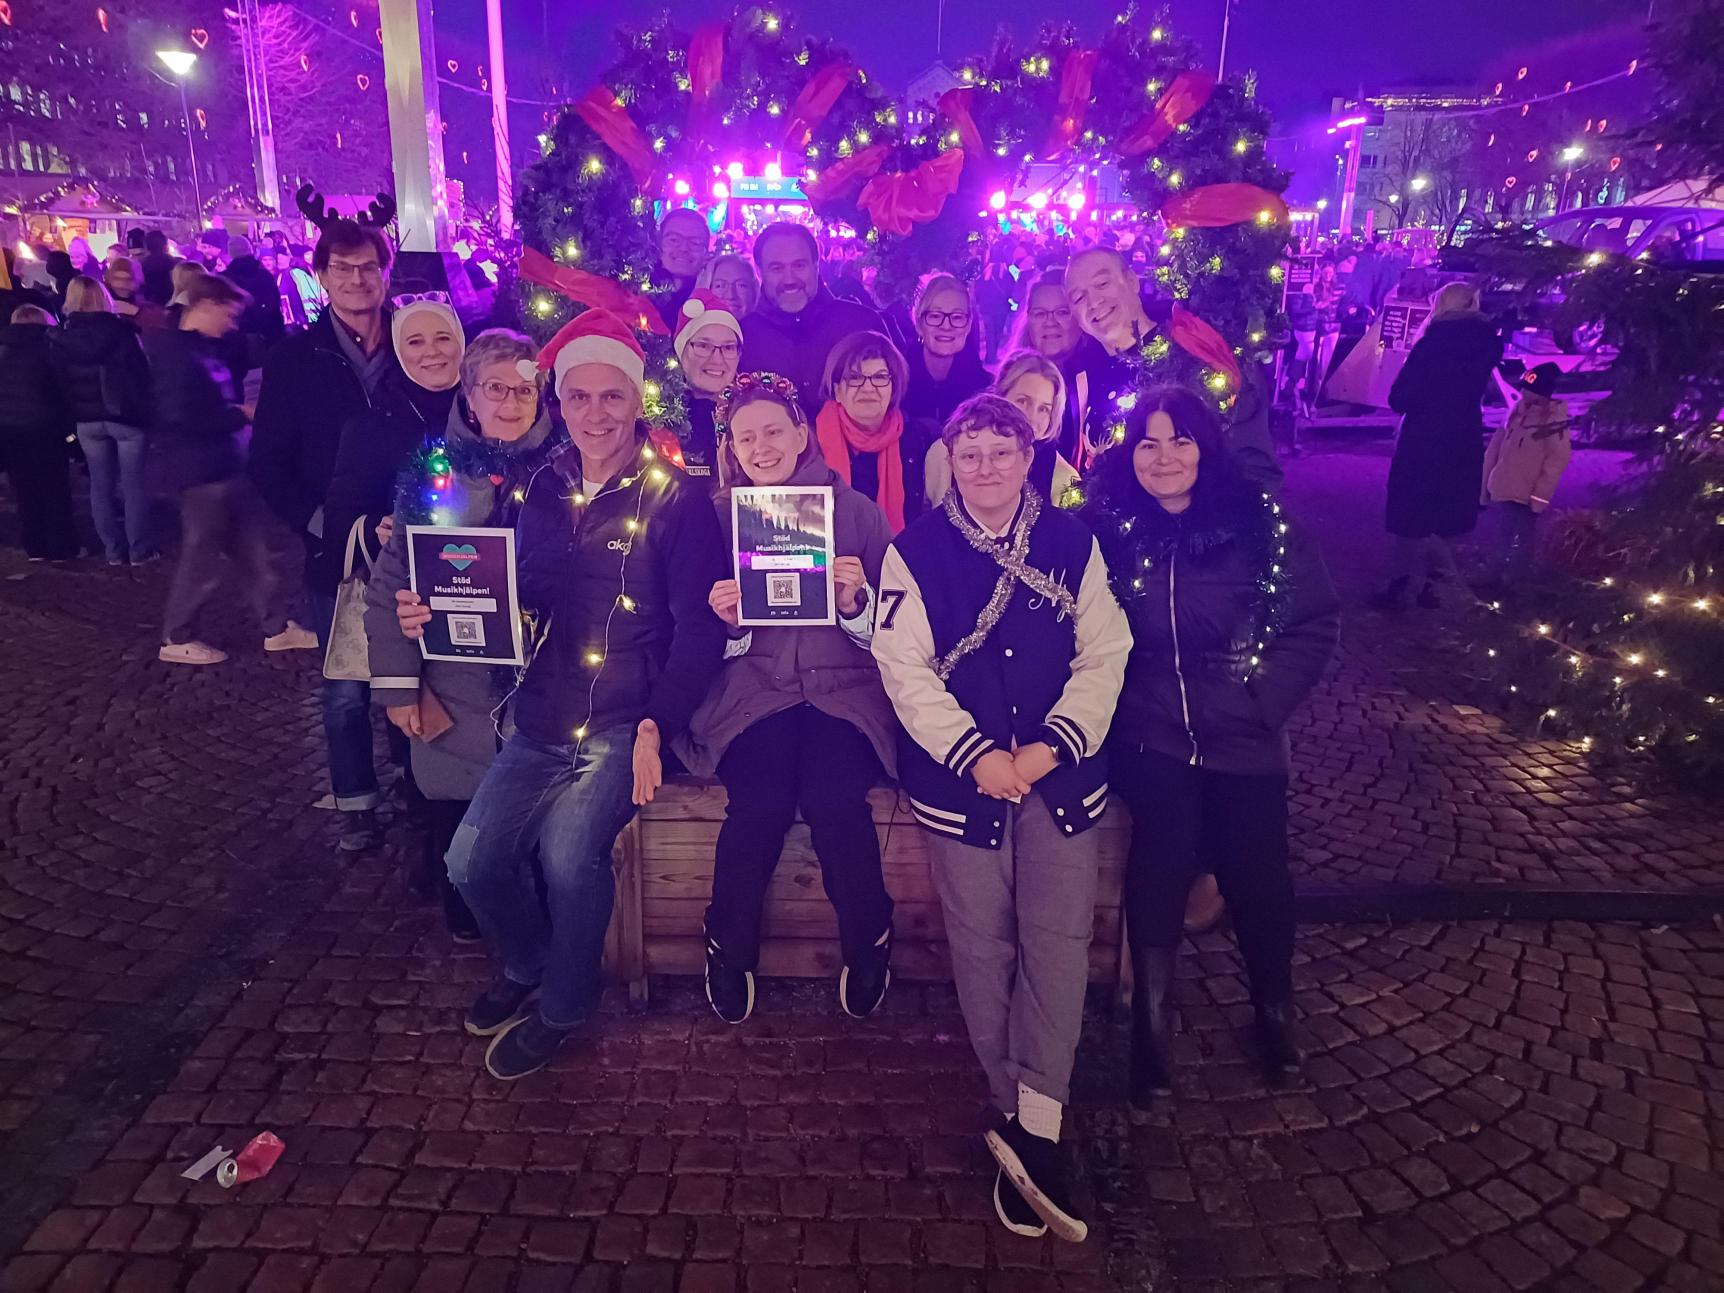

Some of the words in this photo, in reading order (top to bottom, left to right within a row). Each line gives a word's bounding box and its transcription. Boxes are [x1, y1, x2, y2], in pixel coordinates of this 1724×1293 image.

[772, 534, 791, 542] Stöd
[452, 576, 471, 585] Stöd
[434, 584, 490, 596] Musikhjälpen!
[880, 588, 908, 631] 7
